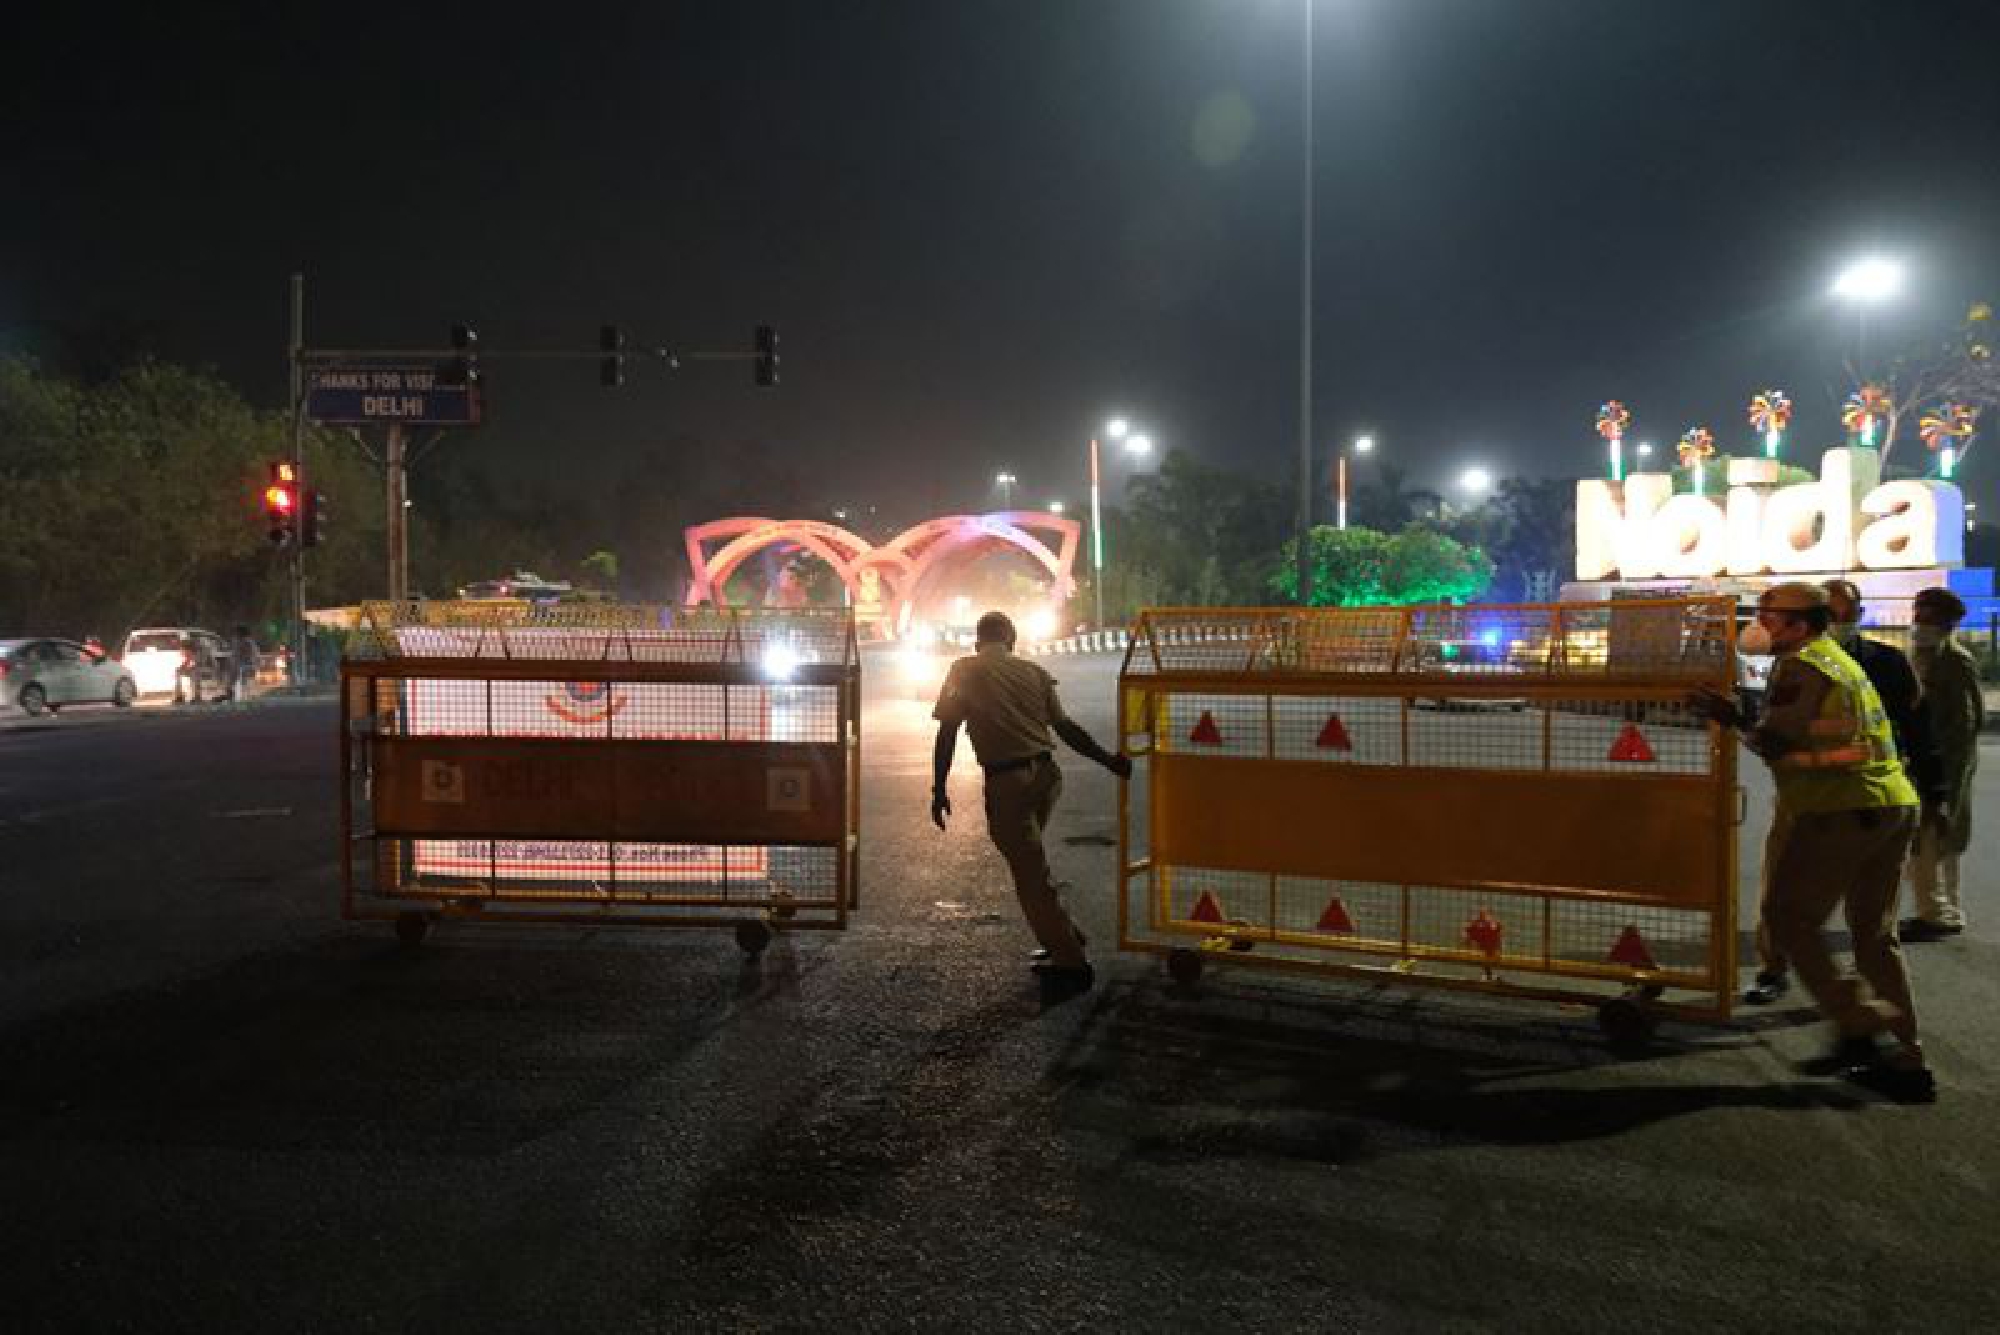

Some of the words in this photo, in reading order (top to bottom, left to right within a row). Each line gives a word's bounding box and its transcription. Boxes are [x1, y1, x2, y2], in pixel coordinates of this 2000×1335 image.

[371, 371, 401, 389] FOR
[364, 396, 423, 416] DELHI
[1577, 446, 1962, 580] Noida
